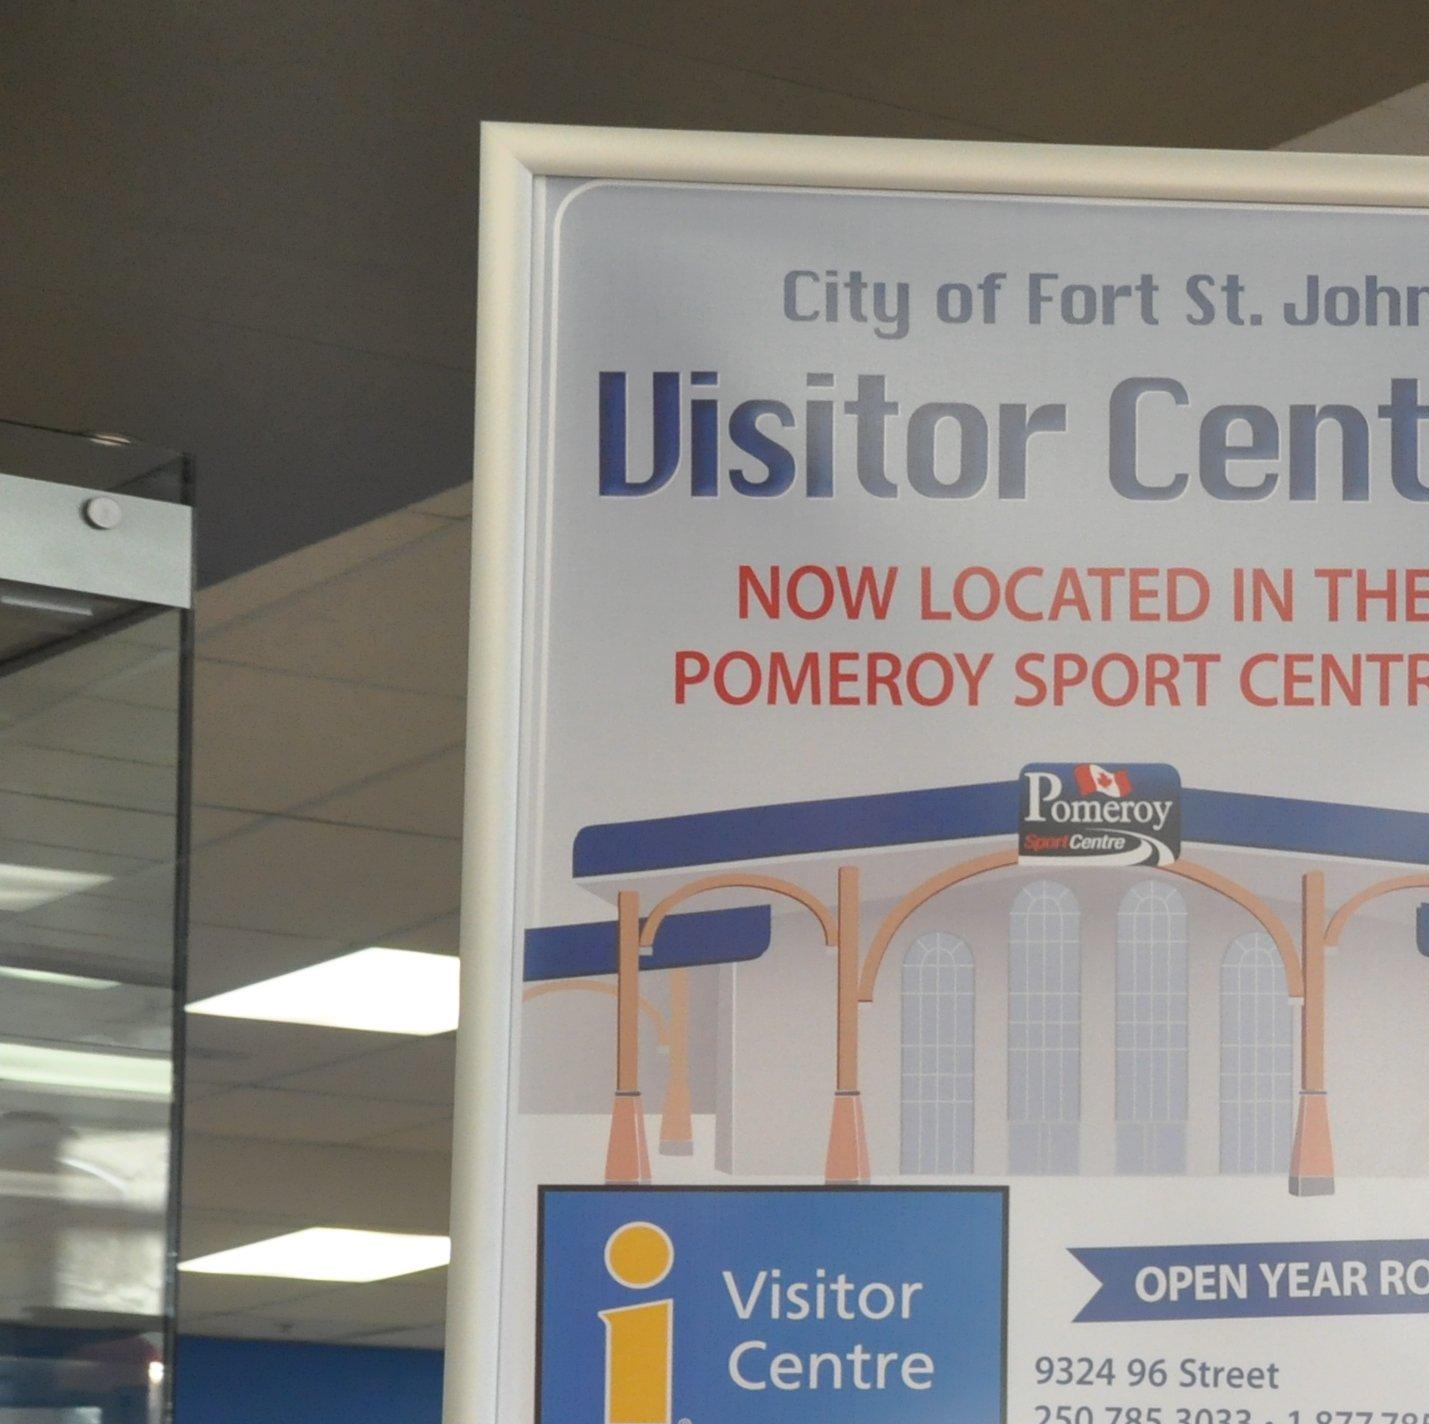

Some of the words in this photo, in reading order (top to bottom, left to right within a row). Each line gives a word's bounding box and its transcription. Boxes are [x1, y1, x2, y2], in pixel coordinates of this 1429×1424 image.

[783, 269, 910, 340] City
[936, 271, 1007, 325] of
[1028, 272, 1159, 326] Fort
[1185, 273, 1263, 327] St.
[599, 370, 1067, 499] Visitor
[738, 564, 898, 621] NOW
[920, 566, 1210, 622] LOCATED
[1233, 568, 1294, 623] IN
[674, 650, 994, 707] POMEROY
[1014, 652, 1221, 708] SPORT
[1024, 772, 1173, 831] Pomeroy
[1024, 832, 1069, 851] Sport
[1069, 834, 1126, 849] Centre
[722, 1269, 924, 1320] Visitor
[1134, 1263, 1248, 1303] OPEN
[1259, 1260, 1370, 1299] YEAR
[728, 1341, 935, 1391] Centre
[1034, 1356, 1116, 1387] 9324
[1126, 1357, 1168, 1388] 96
[1179, 1357, 1280, 1390] Street
